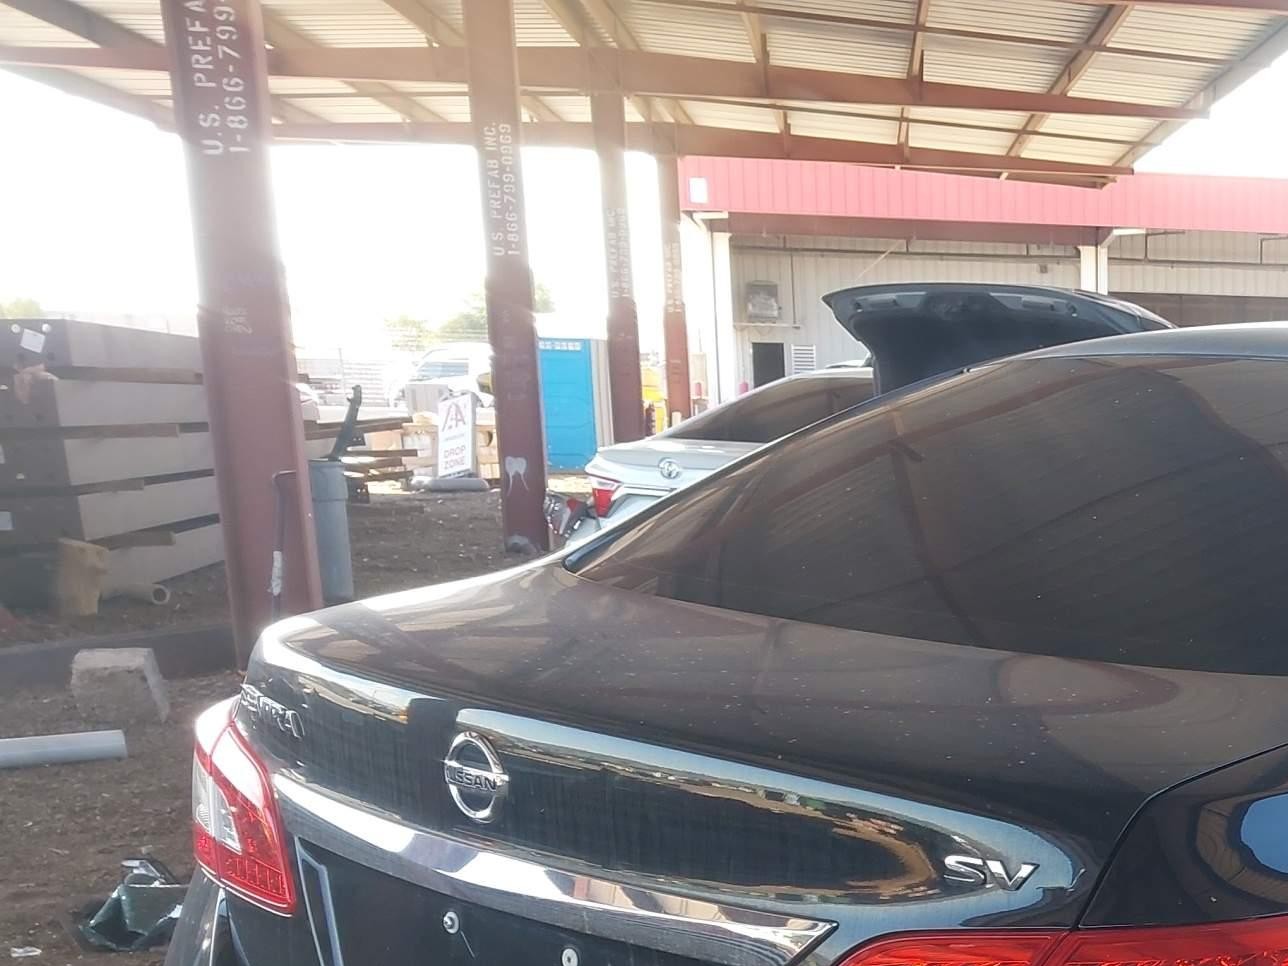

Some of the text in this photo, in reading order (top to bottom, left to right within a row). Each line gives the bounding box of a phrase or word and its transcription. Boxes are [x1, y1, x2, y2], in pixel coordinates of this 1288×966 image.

[212, 0, 250, 152] 1-866-799
[199, 105, 224, 156] U.S.
[487, 159, 502, 218] PREFAB
[443, 445, 466, 459] DROP
[443, 457, 466, 471] ZONE
[446, 764, 498, 793] NISSAN
[943, 855, 1040, 892] SV
